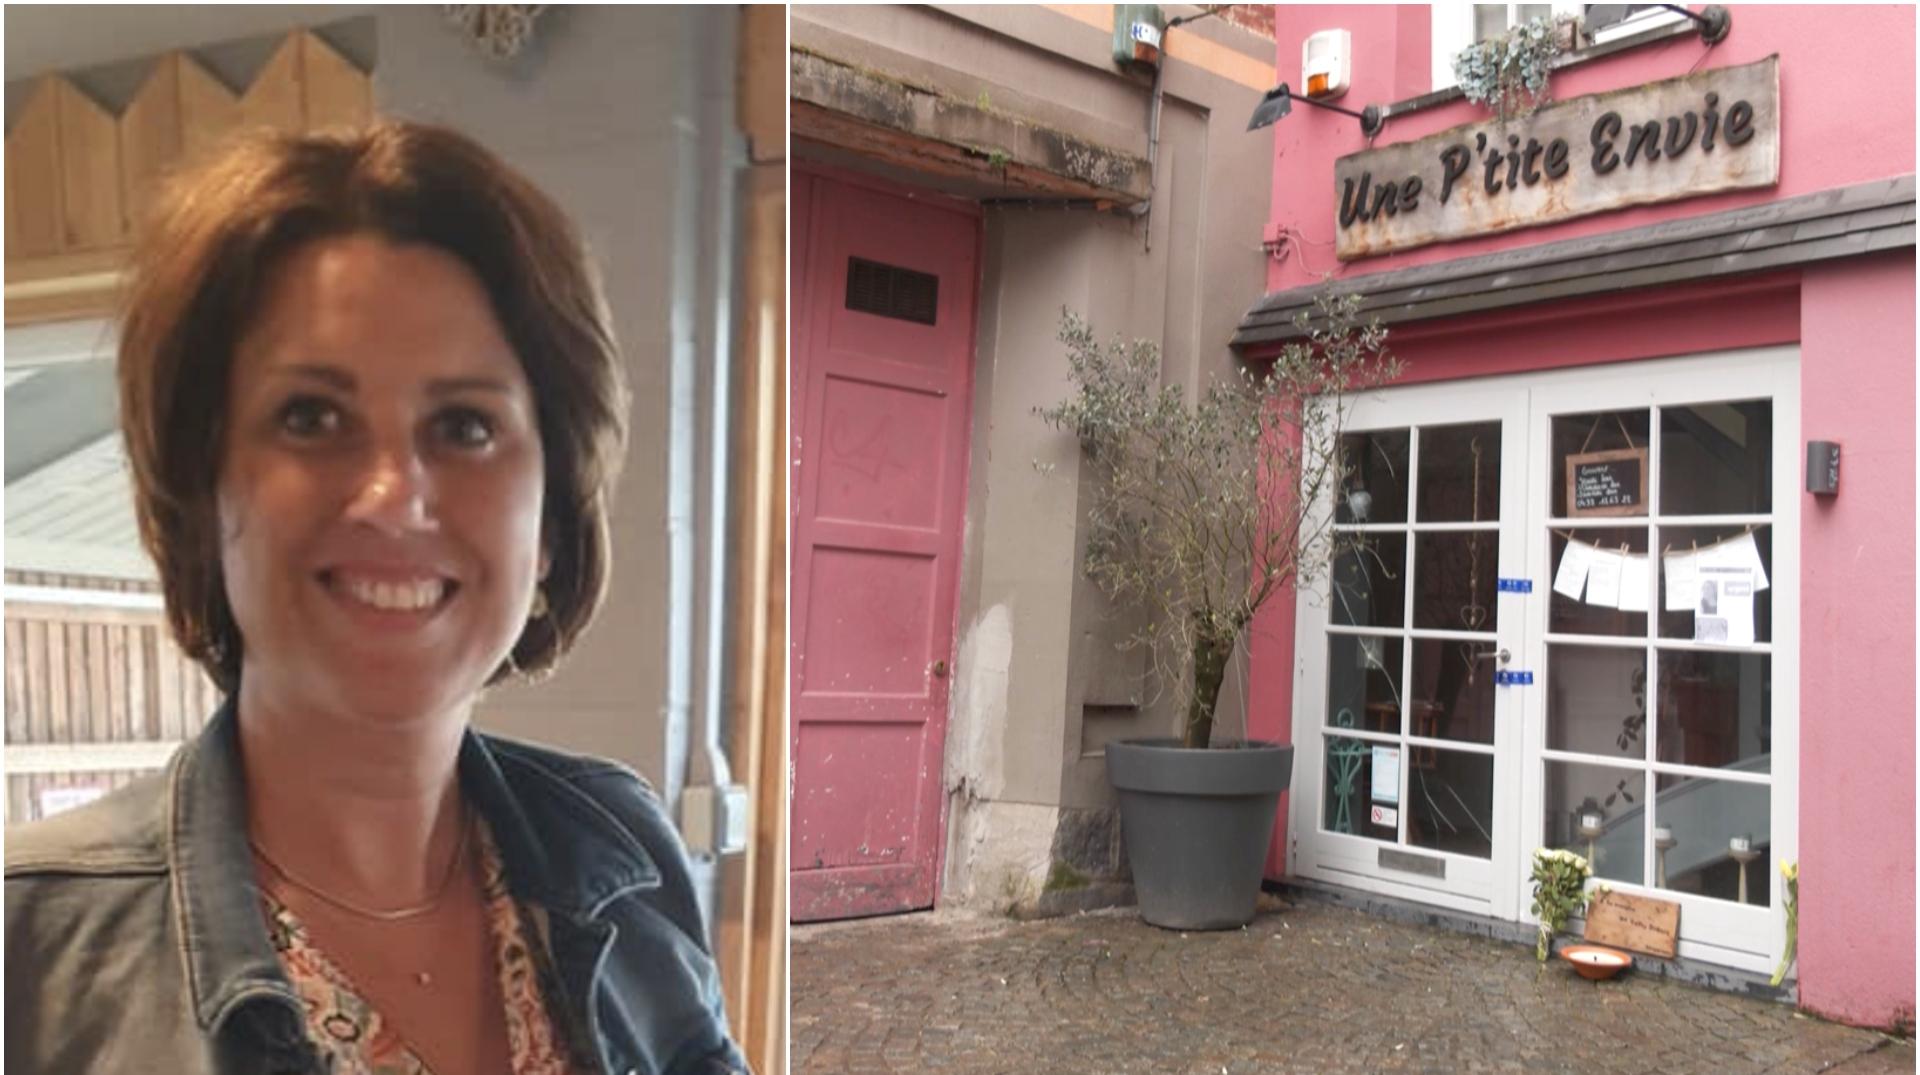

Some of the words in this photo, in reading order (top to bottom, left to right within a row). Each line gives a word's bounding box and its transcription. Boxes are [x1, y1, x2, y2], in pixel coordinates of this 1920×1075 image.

[1339, 171, 1423, 229] Une
[1439, 131, 1569, 206] P'tite
[1590, 91, 1755, 176] Envie
